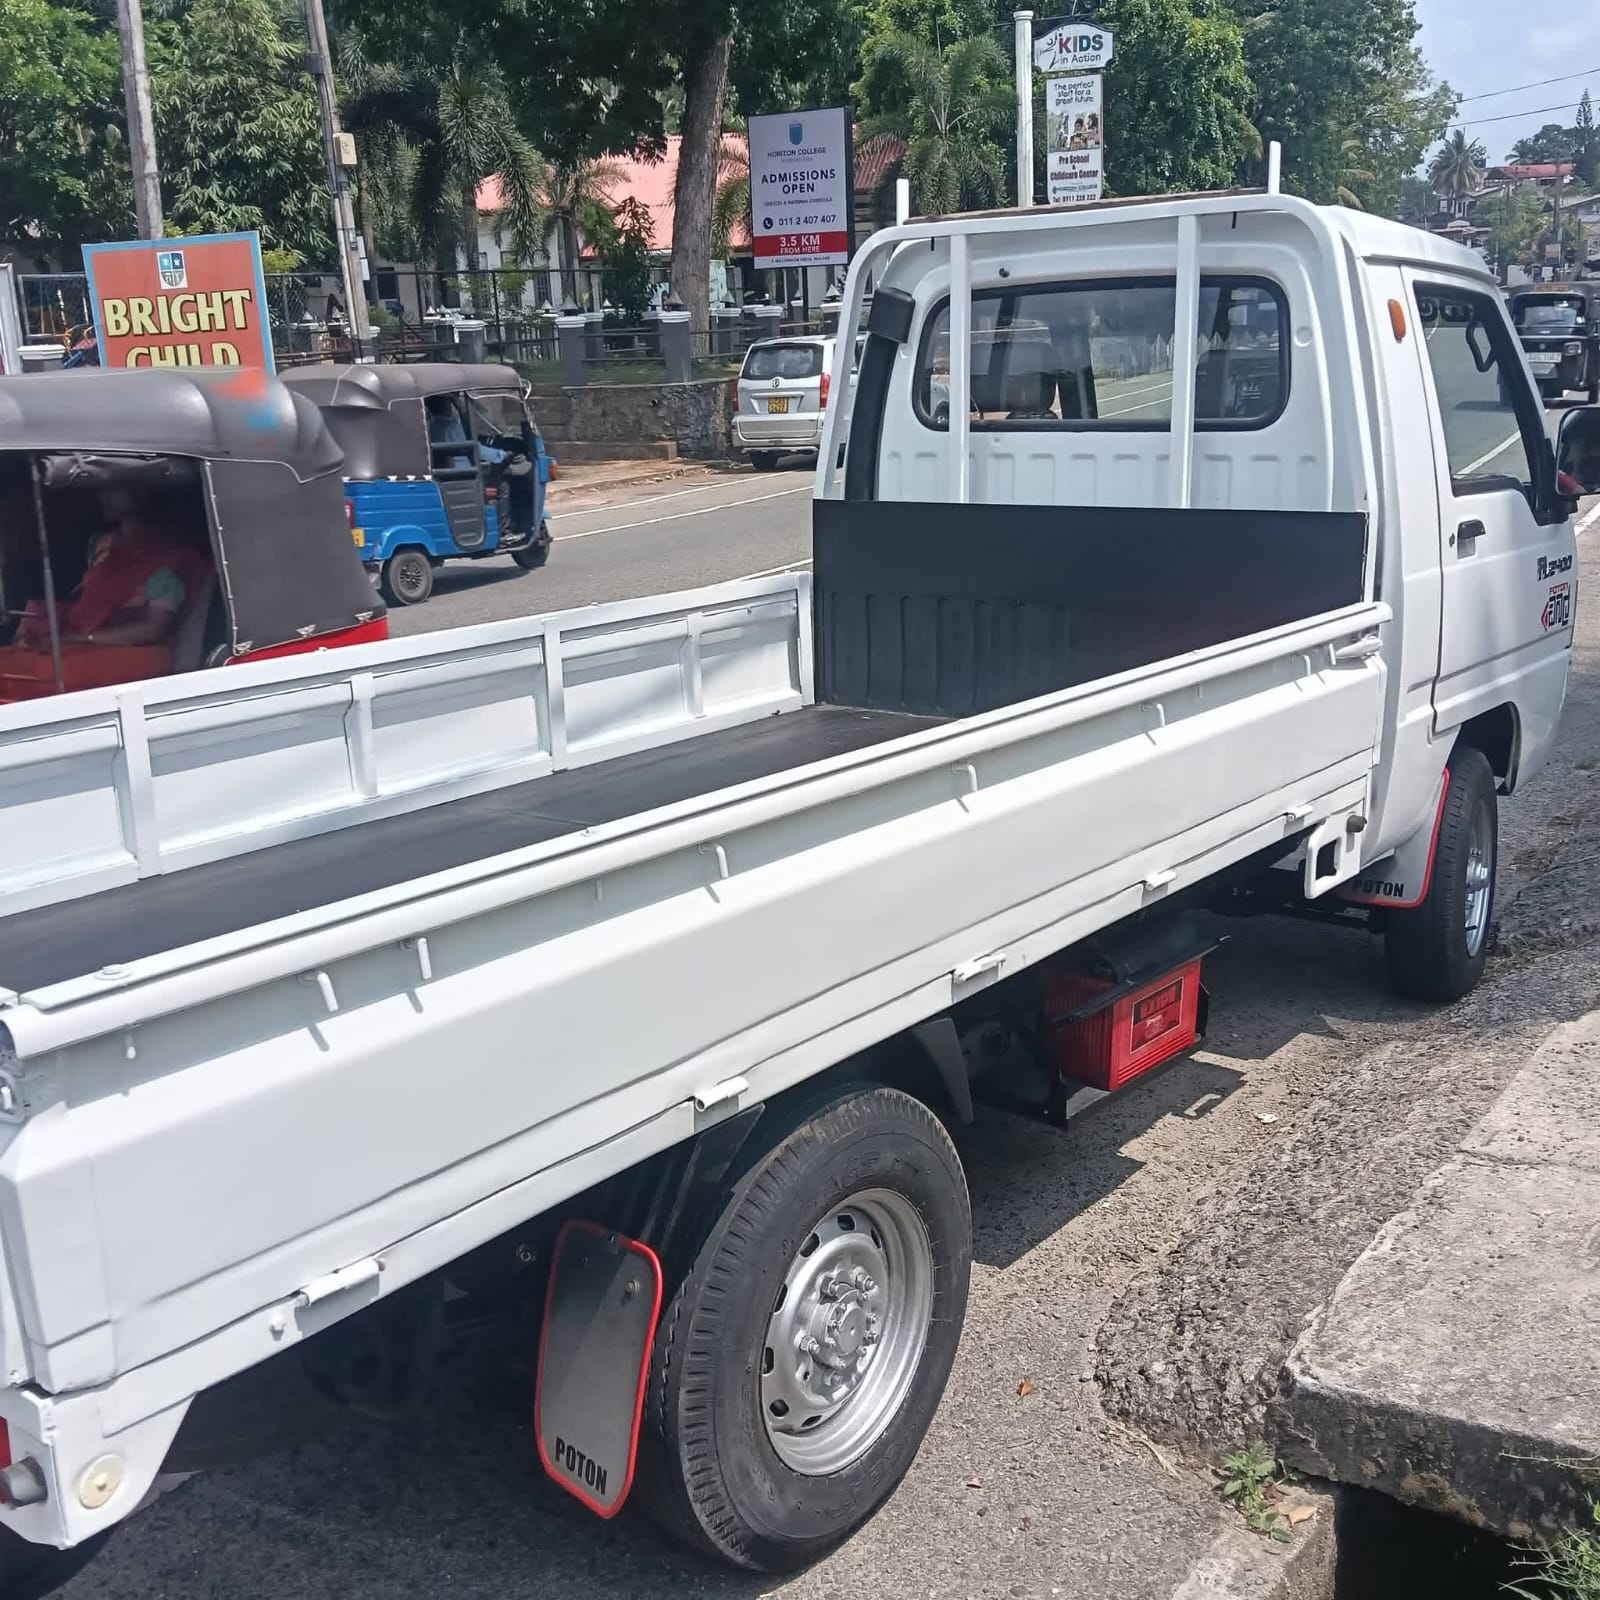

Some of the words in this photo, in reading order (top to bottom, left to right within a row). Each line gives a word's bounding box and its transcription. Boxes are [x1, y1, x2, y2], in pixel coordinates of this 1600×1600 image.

[1059, 34, 1103, 54] KIDS
[1060, 56, 1068, 64] in
[1071, 54, 1101, 64] Action
[1068, 81, 1094, 90] perfect
[1057, 89, 1073, 97] start
[1056, 98, 1073, 106] great
[768, 150, 796, 158] HORIZON
[797, 147, 826, 156] COLLEGE
[1058, 156, 1068, 165] Pre
[1070, 154, 1089, 164] School
[761, 169, 836, 184] ADMISSIONS
[1050, 171, 1078, 180] Childcare
[1079, 170, 1098, 178] Center
[782, 183, 815, 195] OPEN
[778, 218, 793, 226] 011
[796, 217, 801, 225] 2
[803, 216, 818, 225] 407
[821, 214, 836, 223] 407
[780, 235, 797, 247] 3.5
[801, 234, 820, 246] KM
[103, 289, 252, 337] BRIGHT
[555, 1436, 608, 1496] POTON
